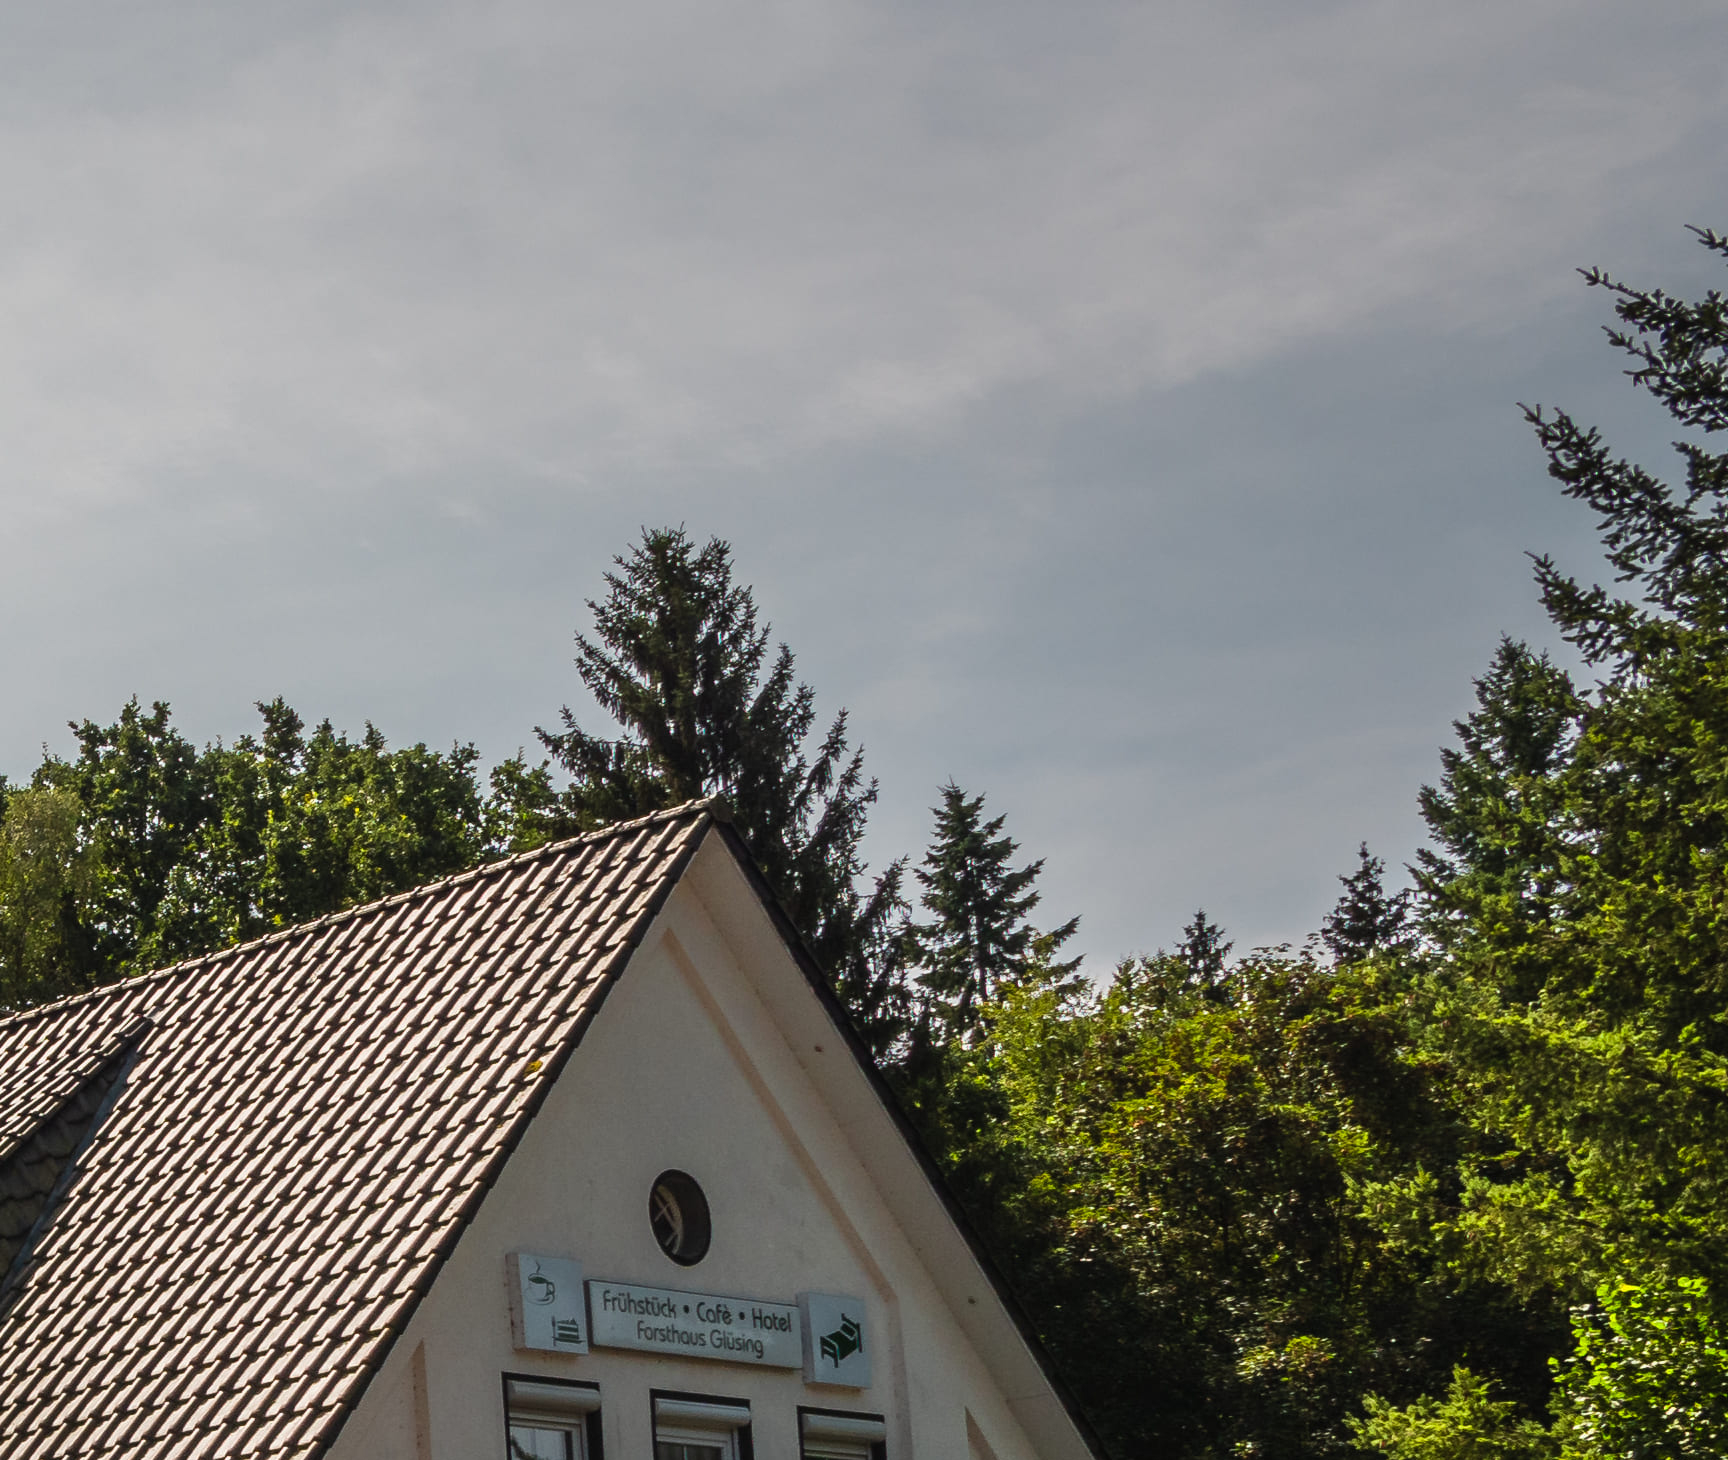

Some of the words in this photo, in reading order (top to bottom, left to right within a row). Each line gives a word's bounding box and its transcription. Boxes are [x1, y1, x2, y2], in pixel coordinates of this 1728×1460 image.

[602, 1290, 676, 1319] Frühstück
[751, 1307, 792, 1332] Hotel
[636, 1320, 707, 1346] Forsthaus
[709, 1329, 764, 1359] Glüsing
